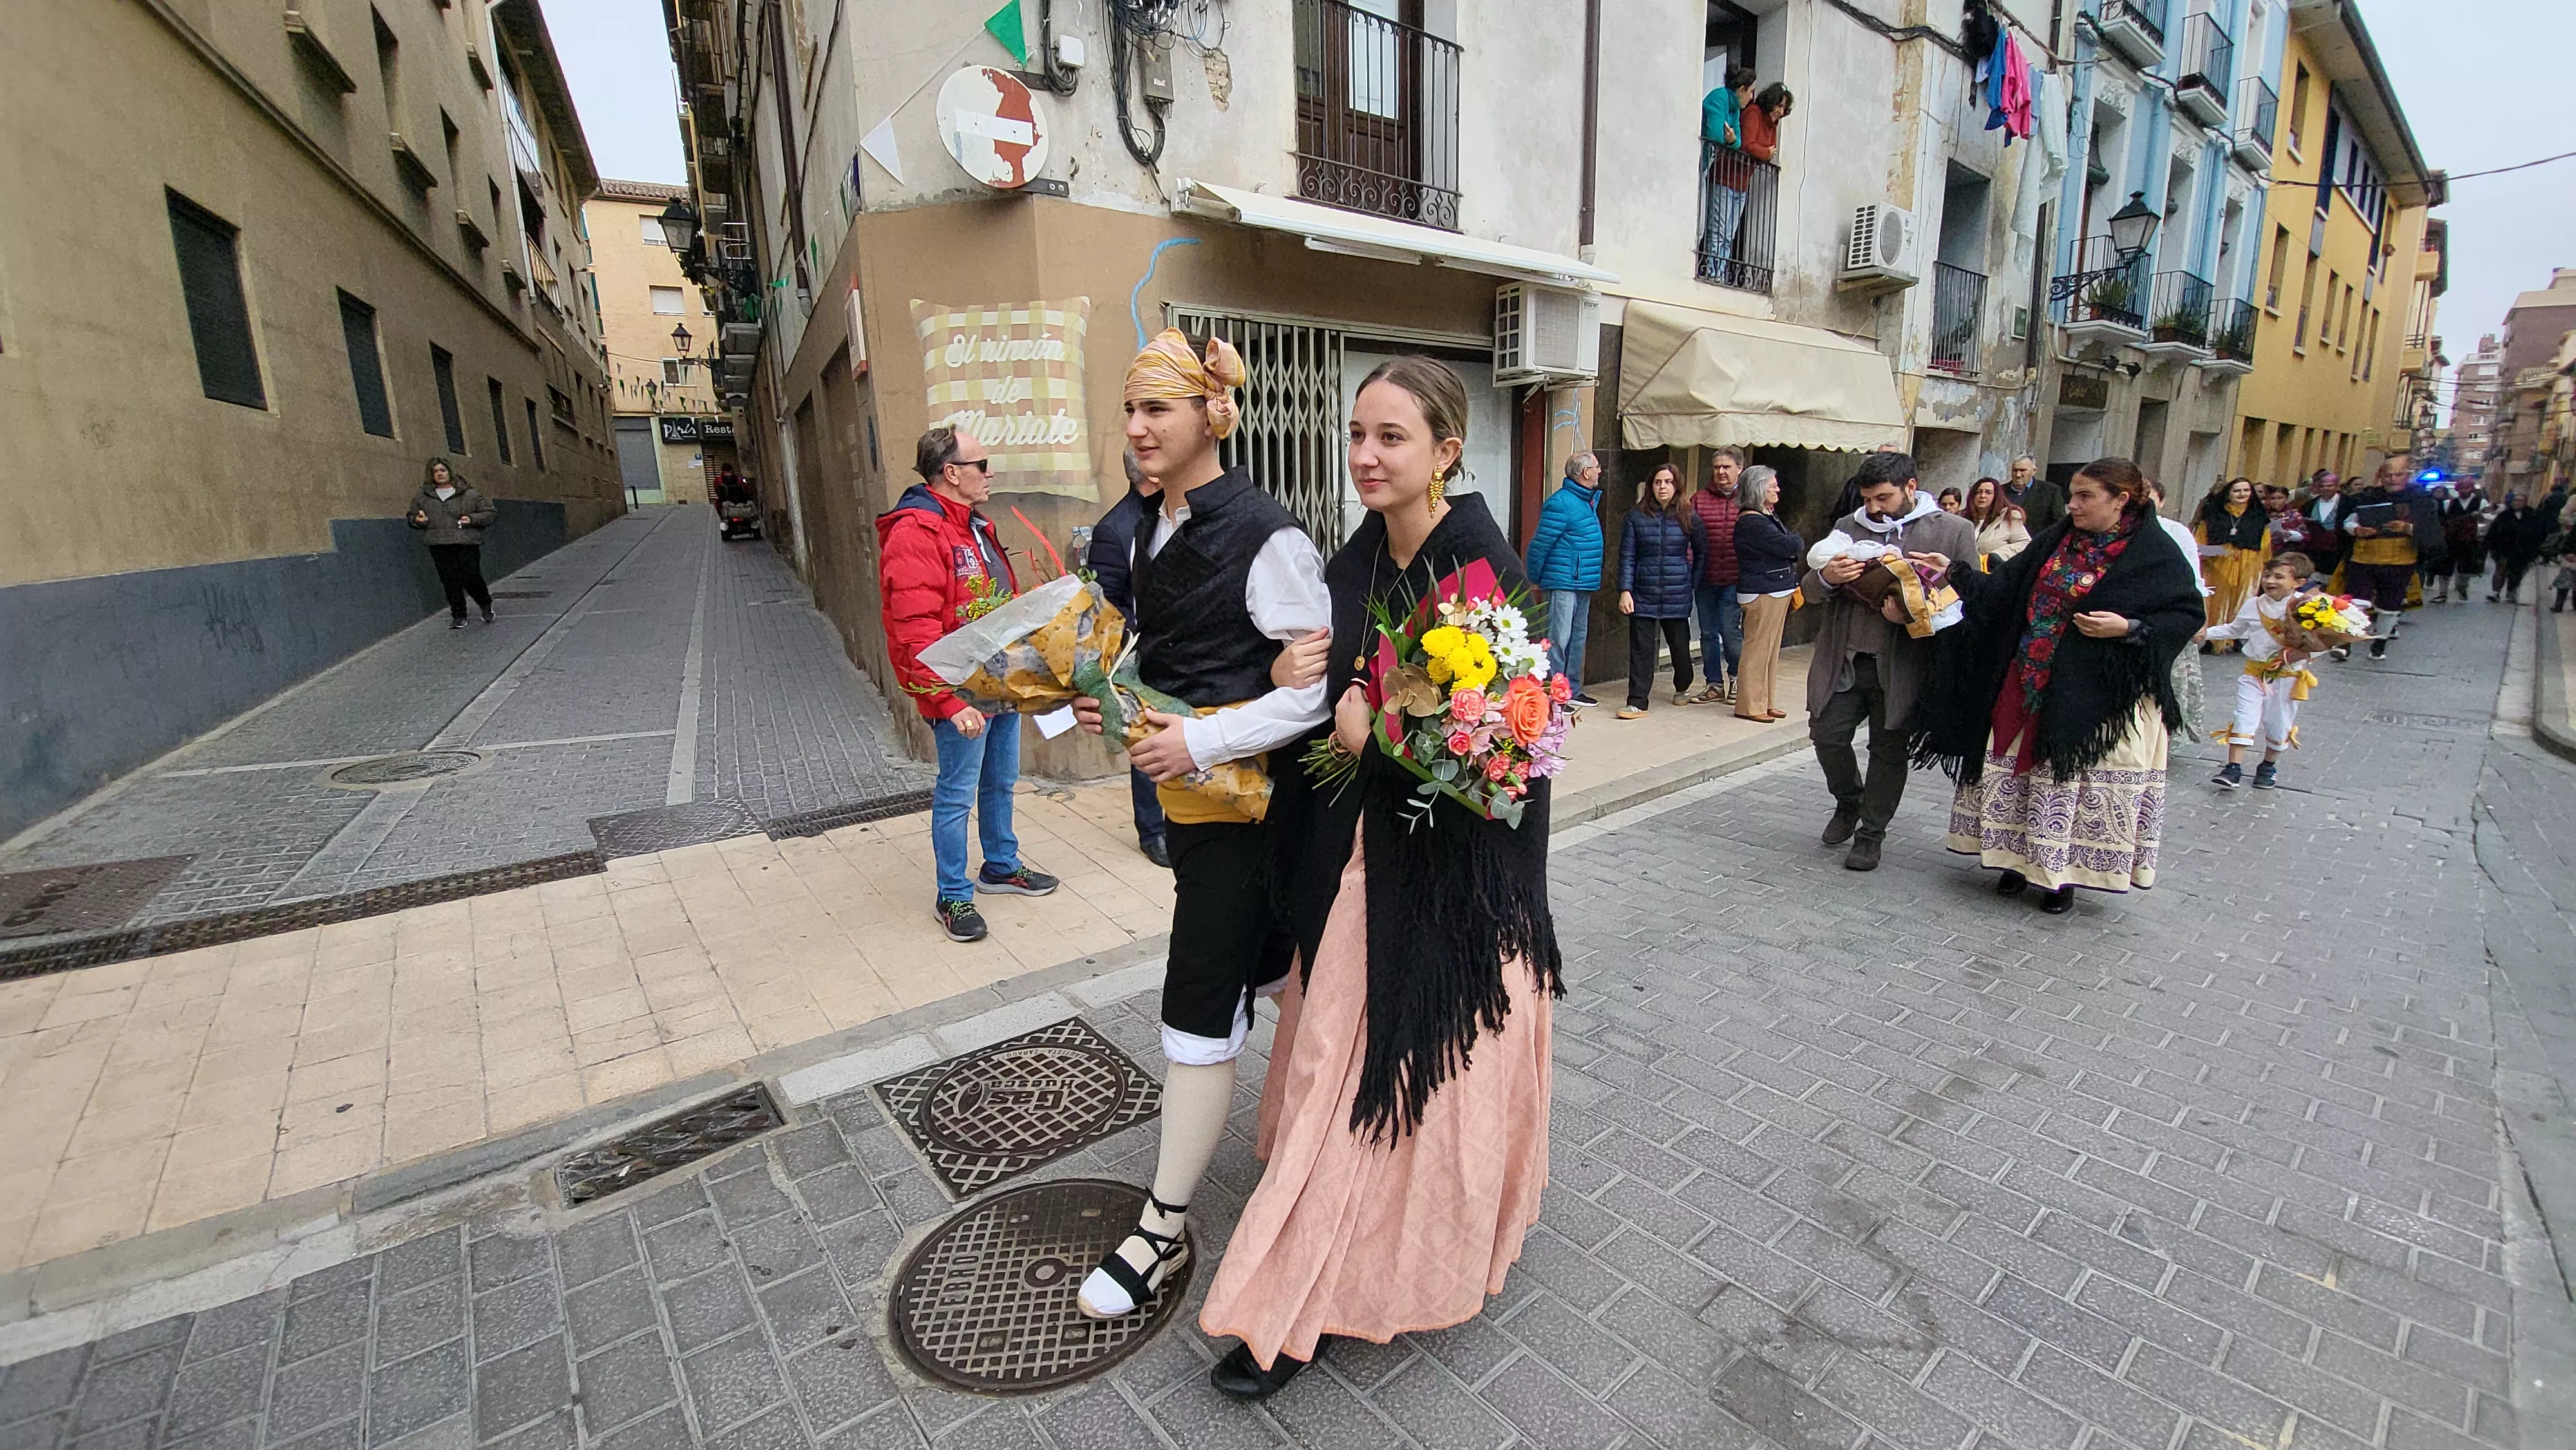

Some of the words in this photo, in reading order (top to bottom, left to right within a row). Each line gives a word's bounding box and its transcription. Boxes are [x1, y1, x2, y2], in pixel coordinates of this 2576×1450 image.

[945, 334, 977, 368] El
[980, 333, 1066, 362] rincón
[990, 376, 1021, 404] de
[990, 1079, 1075, 1089] Huesca
[986, 1089, 1065, 1112] Gas
[939, 1256, 980, 1307] EBRO
